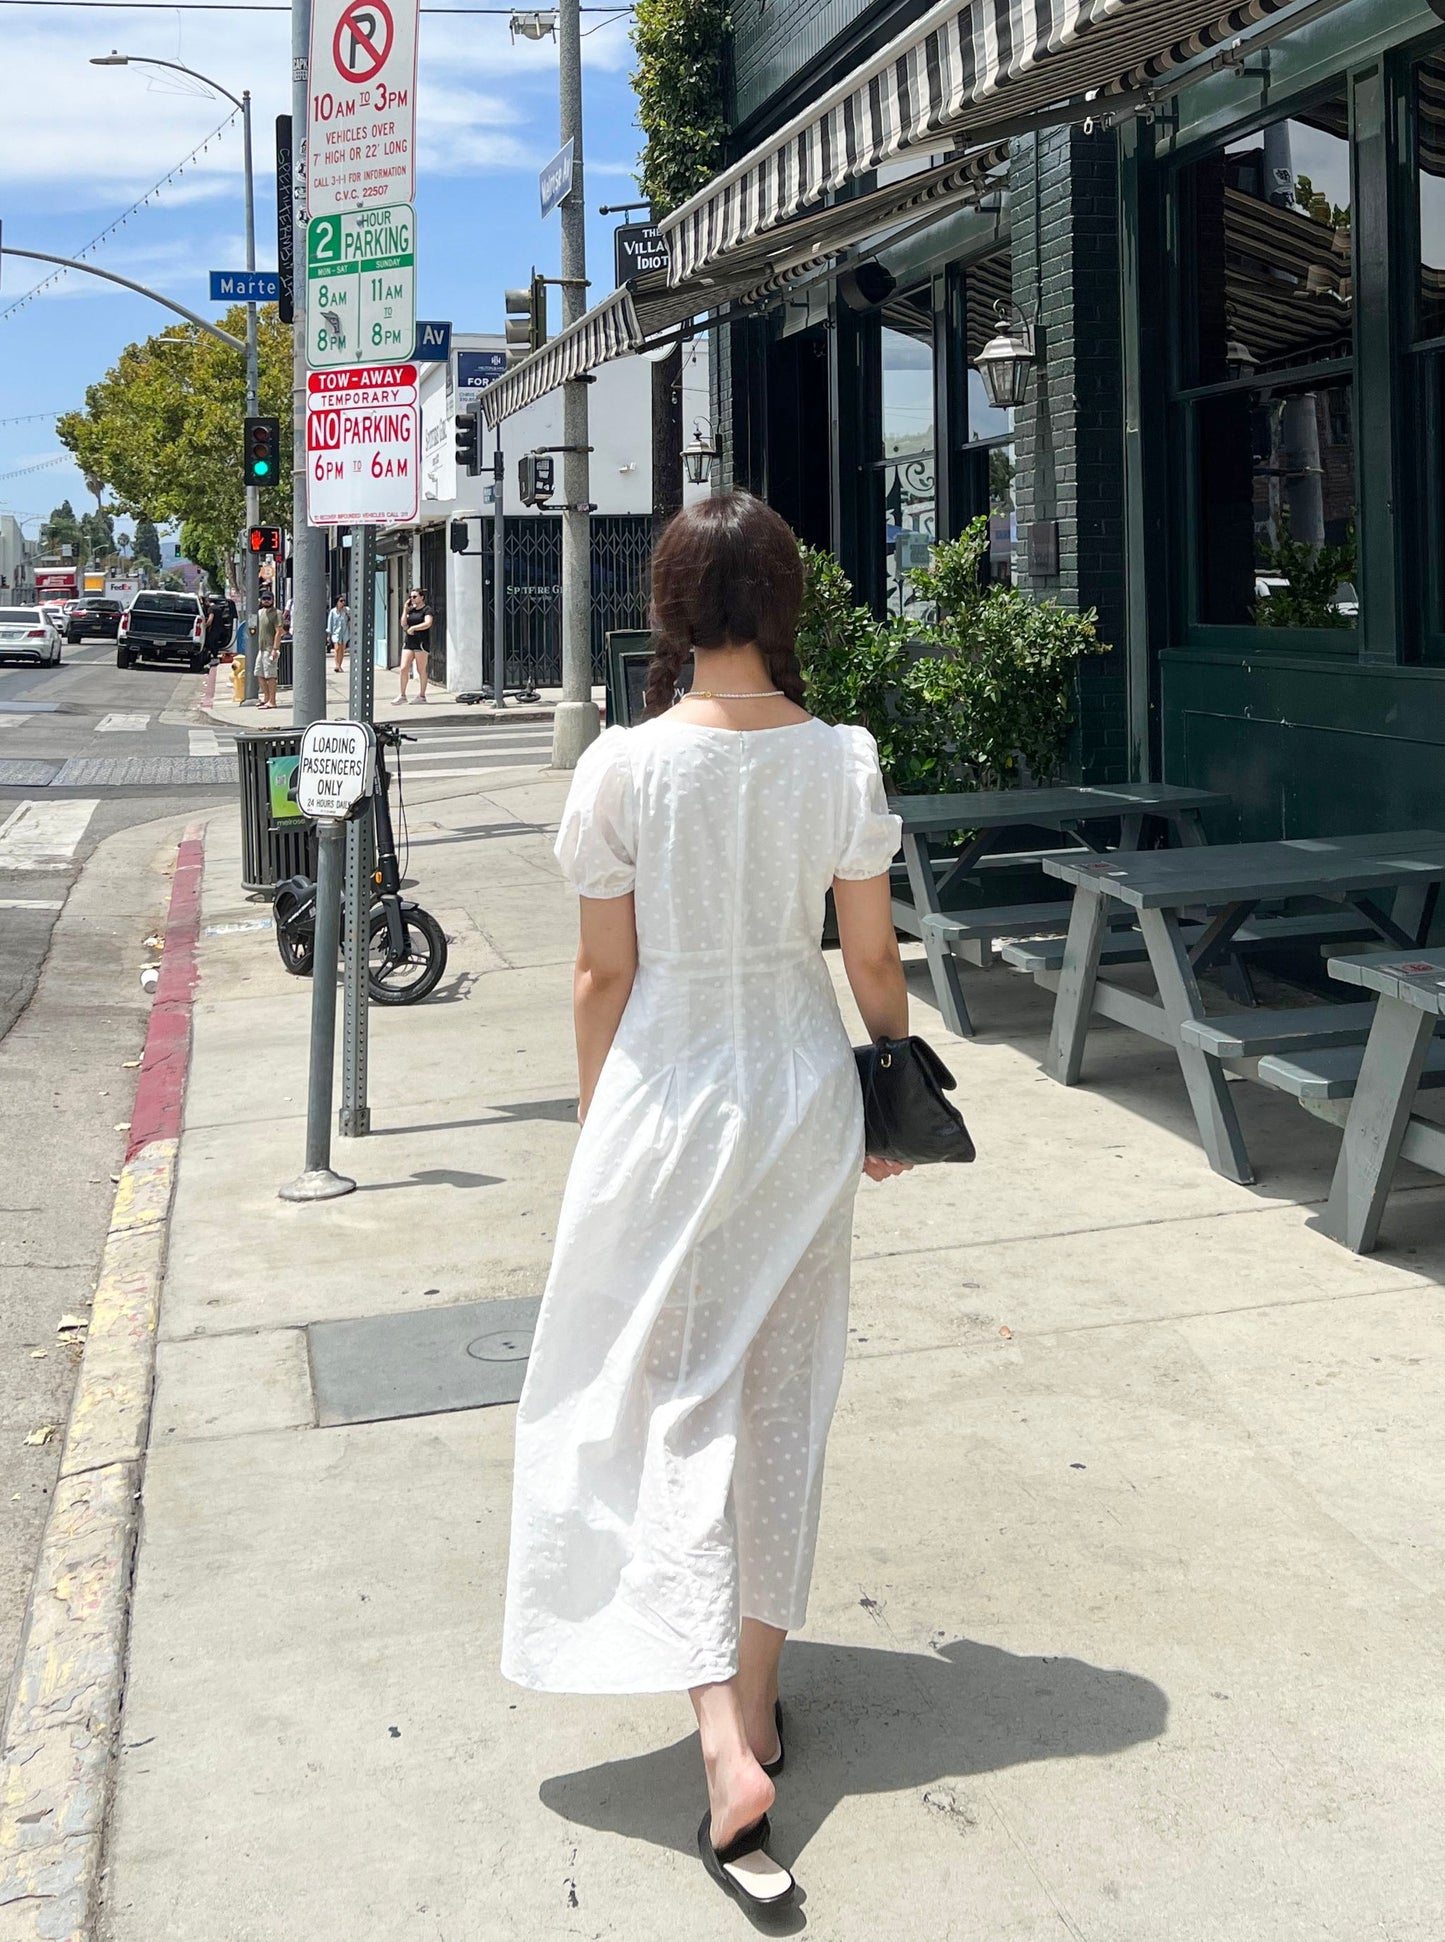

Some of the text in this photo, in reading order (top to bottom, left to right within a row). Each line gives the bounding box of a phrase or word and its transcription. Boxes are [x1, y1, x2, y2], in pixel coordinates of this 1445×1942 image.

[314, 82, 408, 122] 10AM TO 3PM
[326, 122, 394, 144] VEHICLES OVER
[325, 149, 348, 164] HIGH
[350, 147, 361, 161] OR
[384, 140, 408, 155] LONG
[314, 176, 329, 188] CALL
[348, 172, 361, 183] FOR
[364, 166, 406, 181] INFORMATION
[335, 184, 388, 202] C.V.C. 22507
[362, 210, 392, 227] HOUR
[315, 221, 409, 260] 2 PARKING
[642, 229, 662, 238] THE
[624, 242, 667, 255] VILLA
[376, 258, 401, 268] SUNDAY
[637, 256, 668, 270] IDIOT
[220, 278, 276, 294] Marte
[384, 306, 392, 317] TO
[422, 326, 444, 344] Av
[468, 378, 489, 386] FOR
[321, 390, 400, 406] TEMPORARY
[312, 412, 338, 446] NO
[344, 414, 410, 444] PARKING
[353, 460, 362, 471] TO
[506, 585, 550, 594] SPITFIRE
[313, 736, 355, 754] LOADING
[303, 758, 362, 776] PASSENGERS
[318, 780, 343, 796] ONLY
[316, 800, 334, 808] HOURS
